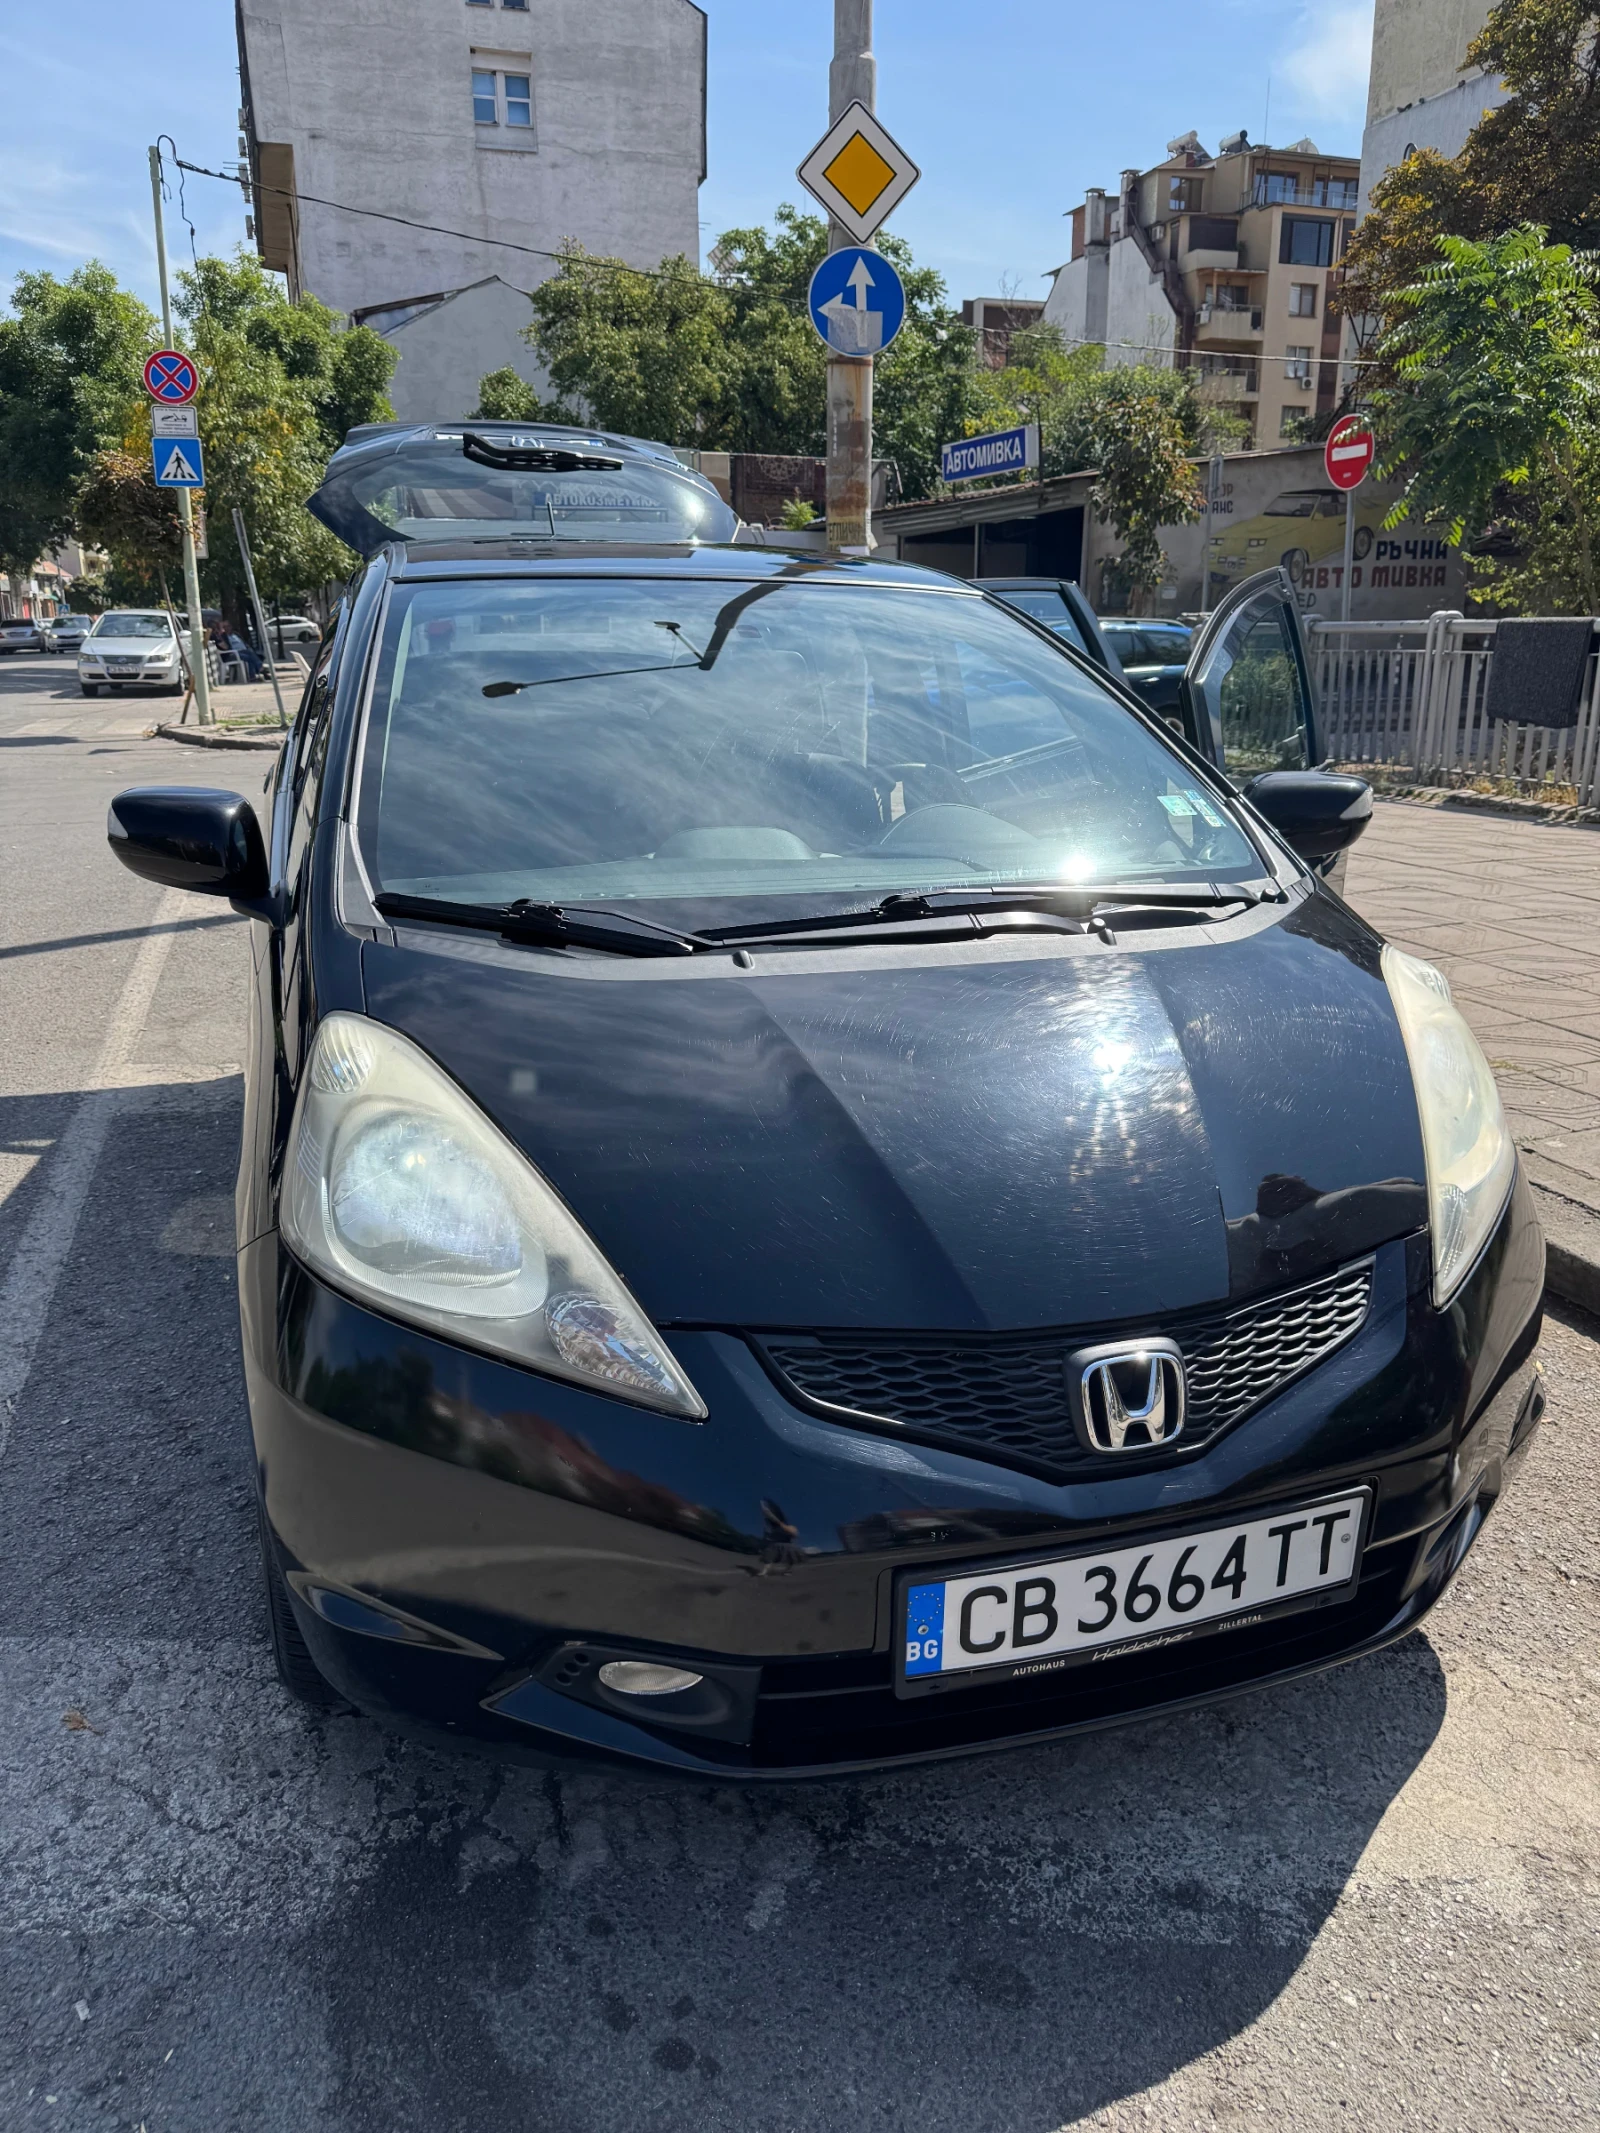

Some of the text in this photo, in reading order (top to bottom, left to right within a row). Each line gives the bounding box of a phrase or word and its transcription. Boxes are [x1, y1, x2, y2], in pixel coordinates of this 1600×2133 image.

[946, 437, 1022, 475] АВТОМИВКА
[1376, 540, 1448, 560] РЪЧНА
[1302, 567, 1362, 589] АВТО
[959, 1509, 1351, 1654] CB 3664 TT
[906, 1639, 938, 1662] BG
[1012, 1659, 1066, 1676] AUTOHAUS
[1218, 1614, 1262, 1631] ZILLERTAL
